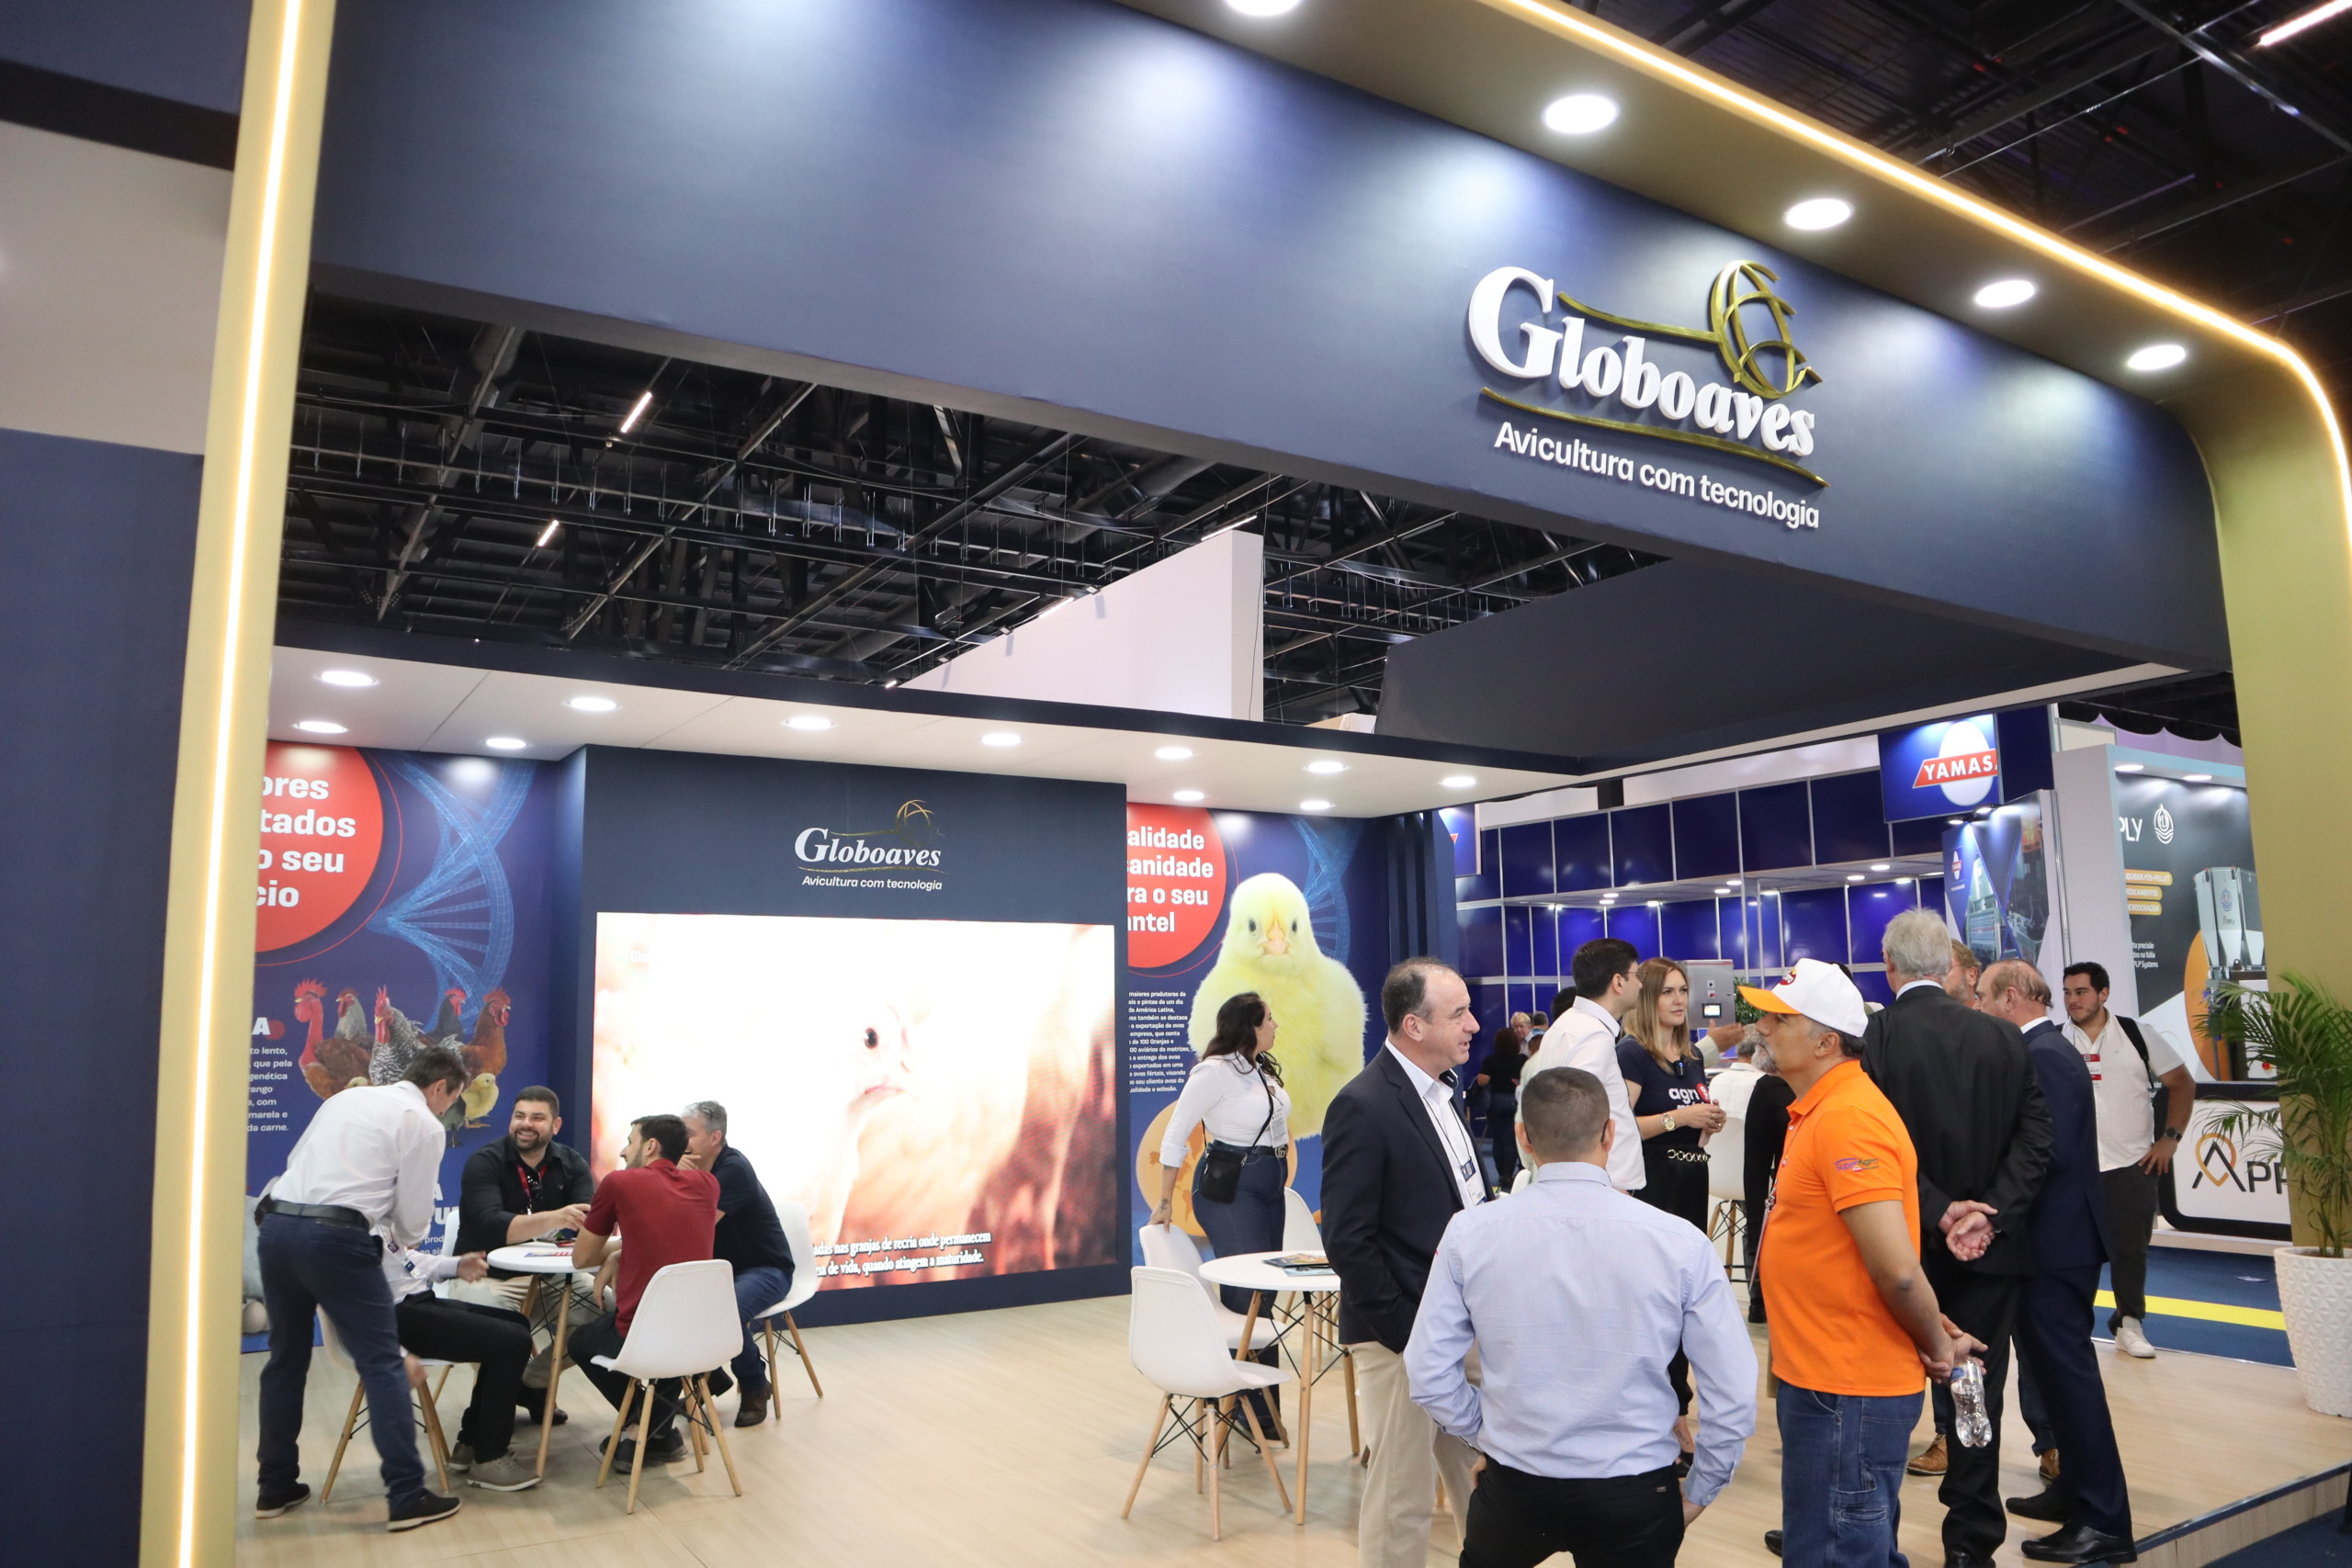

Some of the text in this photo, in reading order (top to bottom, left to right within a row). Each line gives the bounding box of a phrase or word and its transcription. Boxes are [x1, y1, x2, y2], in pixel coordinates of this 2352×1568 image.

[1467, 265, 1815, 457] Globoaves
[1493, 421, 1820, 530] Avicultura com tecnologia
[1923, 754, 1997, 781] YAMAS
[260, 808, 356, 838] tados
[794, 827, 942, 866] Globoaves
[1126, 826, 1204, 851] alidade
[281, 850, 345, 873] seu
[1126, 854, 1214, 878] anidade
[801, 875, 943, 892] Avicultura com tecnologia
[1152, 888, 1166, 904] o
[1170, 888, 1209, 906] seu
[252, 1017, 271, 1035] A
[262, 1046, 288, 1055] lento,
[273, 1060, 292, 1068] pela
[249, 1072, 288, 1082] genética
[248, 1111, 280, 1119] marela
[247, 1123, 259, 1132] da
[435, 1206, 459, 1224] U
[834, 1243, 850, 1255] nas
[850, 1238, 881, 1258] granjas
[881, 1236, 893, 1251] de
[894, 1235, 918, 1250] recria
[919, 1233, 940, 1247] onde
[940, 1232, 991, 1250] permanecem
[828, 1261, 840, 1276] de
[840, 1259, 862, 1275] vida,
[862, 1257, 895, 1277] quando
[895, 1256, 929, 1273] atingem
[929, 1257, 935, 1267] a
[936, 1248, 985, 1267] maturidade.
